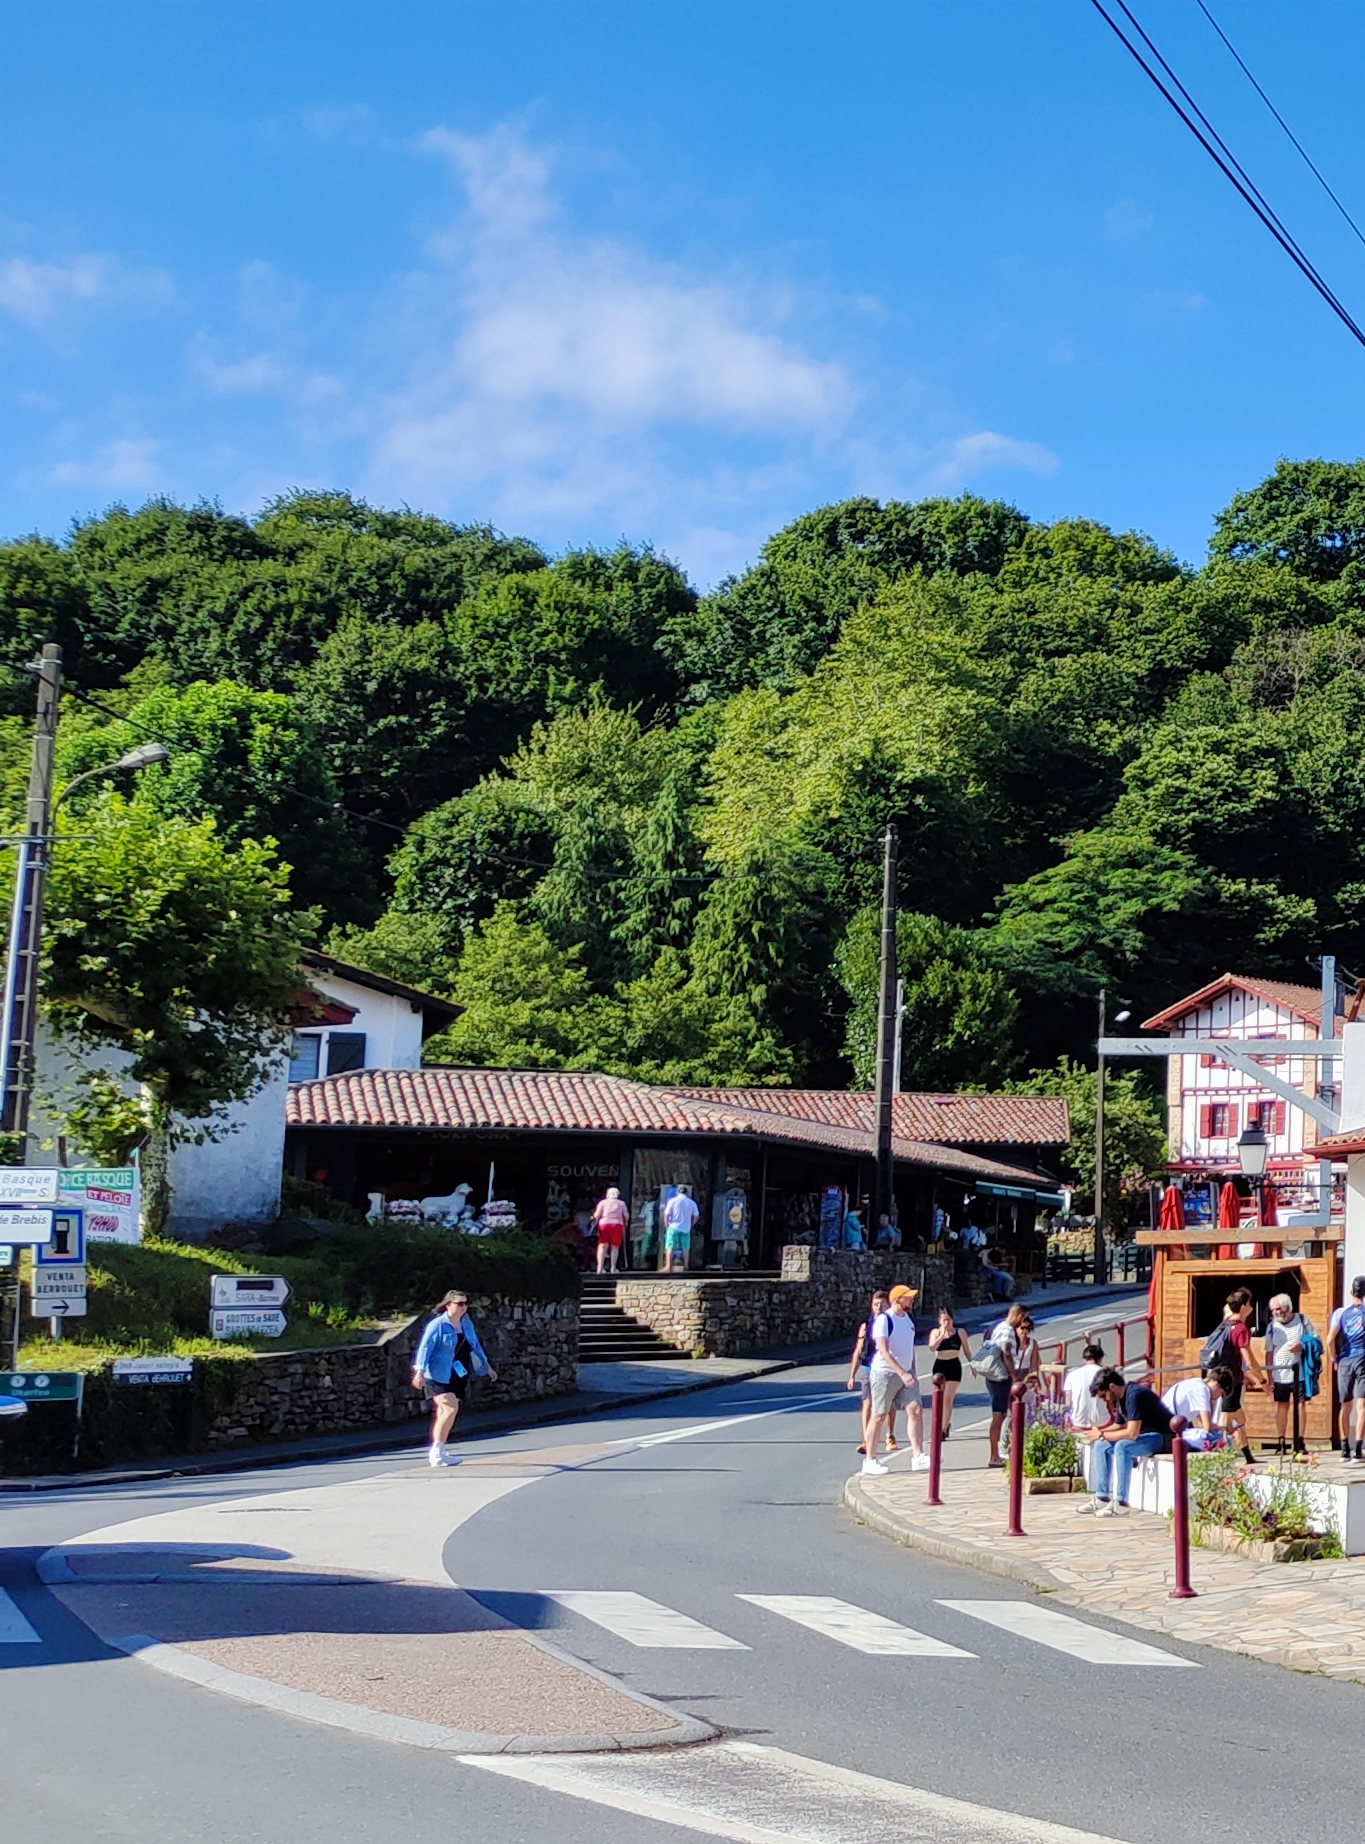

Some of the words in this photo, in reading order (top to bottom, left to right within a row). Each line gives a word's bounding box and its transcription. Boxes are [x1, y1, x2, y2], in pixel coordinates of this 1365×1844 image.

[2, 1173, 51, 1186] Basque
[86, 1172, 132, 1187] BASQUE
[88, 1190, 99, 1199] ET
[100, 1190, 130, 1205] PELOTE
[11, 1214, 48, 1225] Brebis
[46, 1272, 75, 1281] VENTA
[37, 1284, 84, 1293] BERROUET
[226, 1314, 256, 1323] GROTTES
